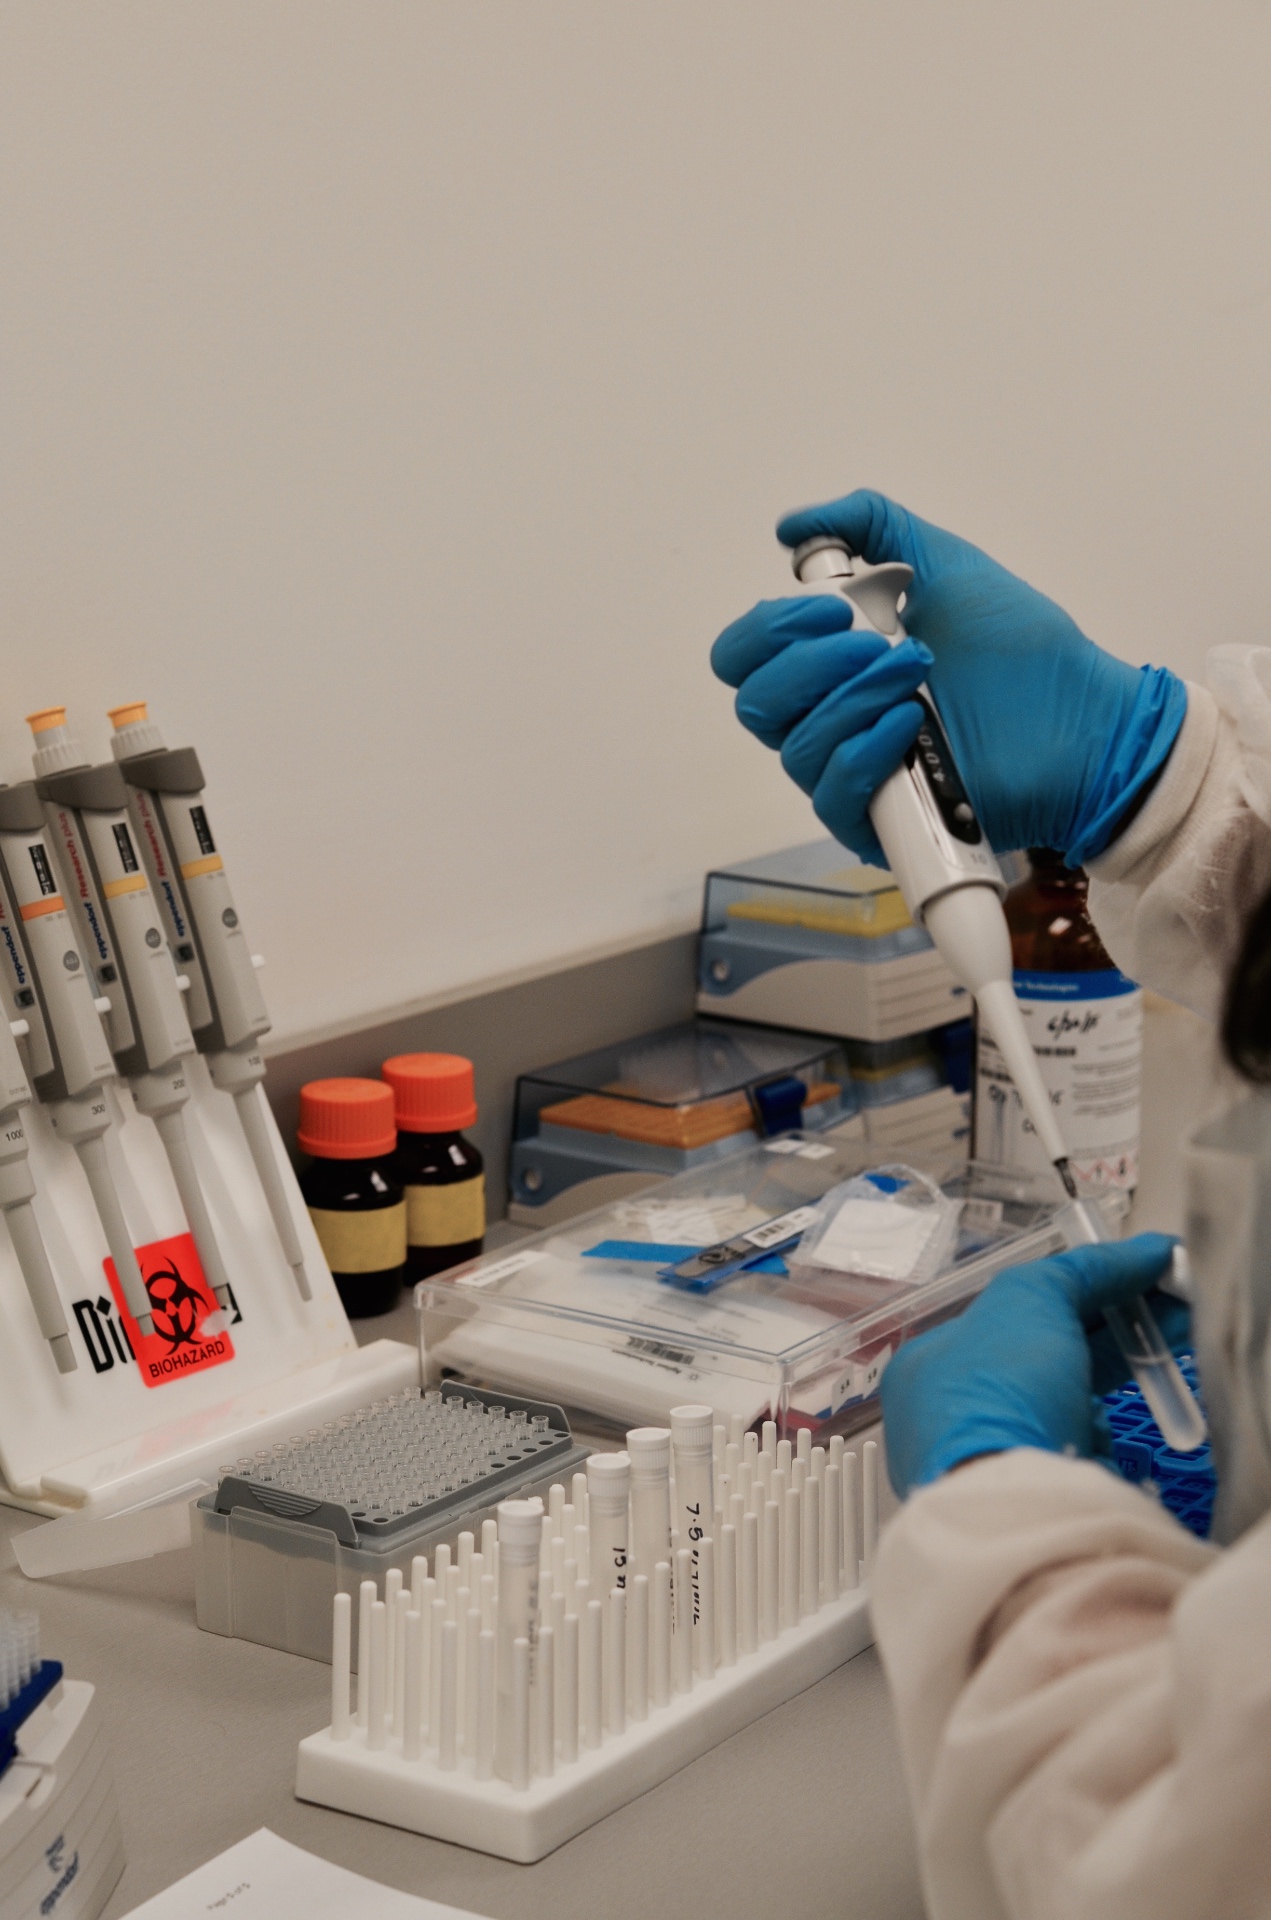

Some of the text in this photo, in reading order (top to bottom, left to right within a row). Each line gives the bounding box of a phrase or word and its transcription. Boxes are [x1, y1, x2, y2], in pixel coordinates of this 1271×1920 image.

[66, 838, 90, 899] Research
[143, 819, 167, 878] Research
[83, 902, 108, 960] eppendorf
[161, 880, 185, 937] eppendorf
[1, 925, 25, 985] eppendorf
[91, 1104, 106, 1115] 300
[148, 1340, 226, 1378] BIOHAZARD
[686, 1503, 703, 1541] 7.5
